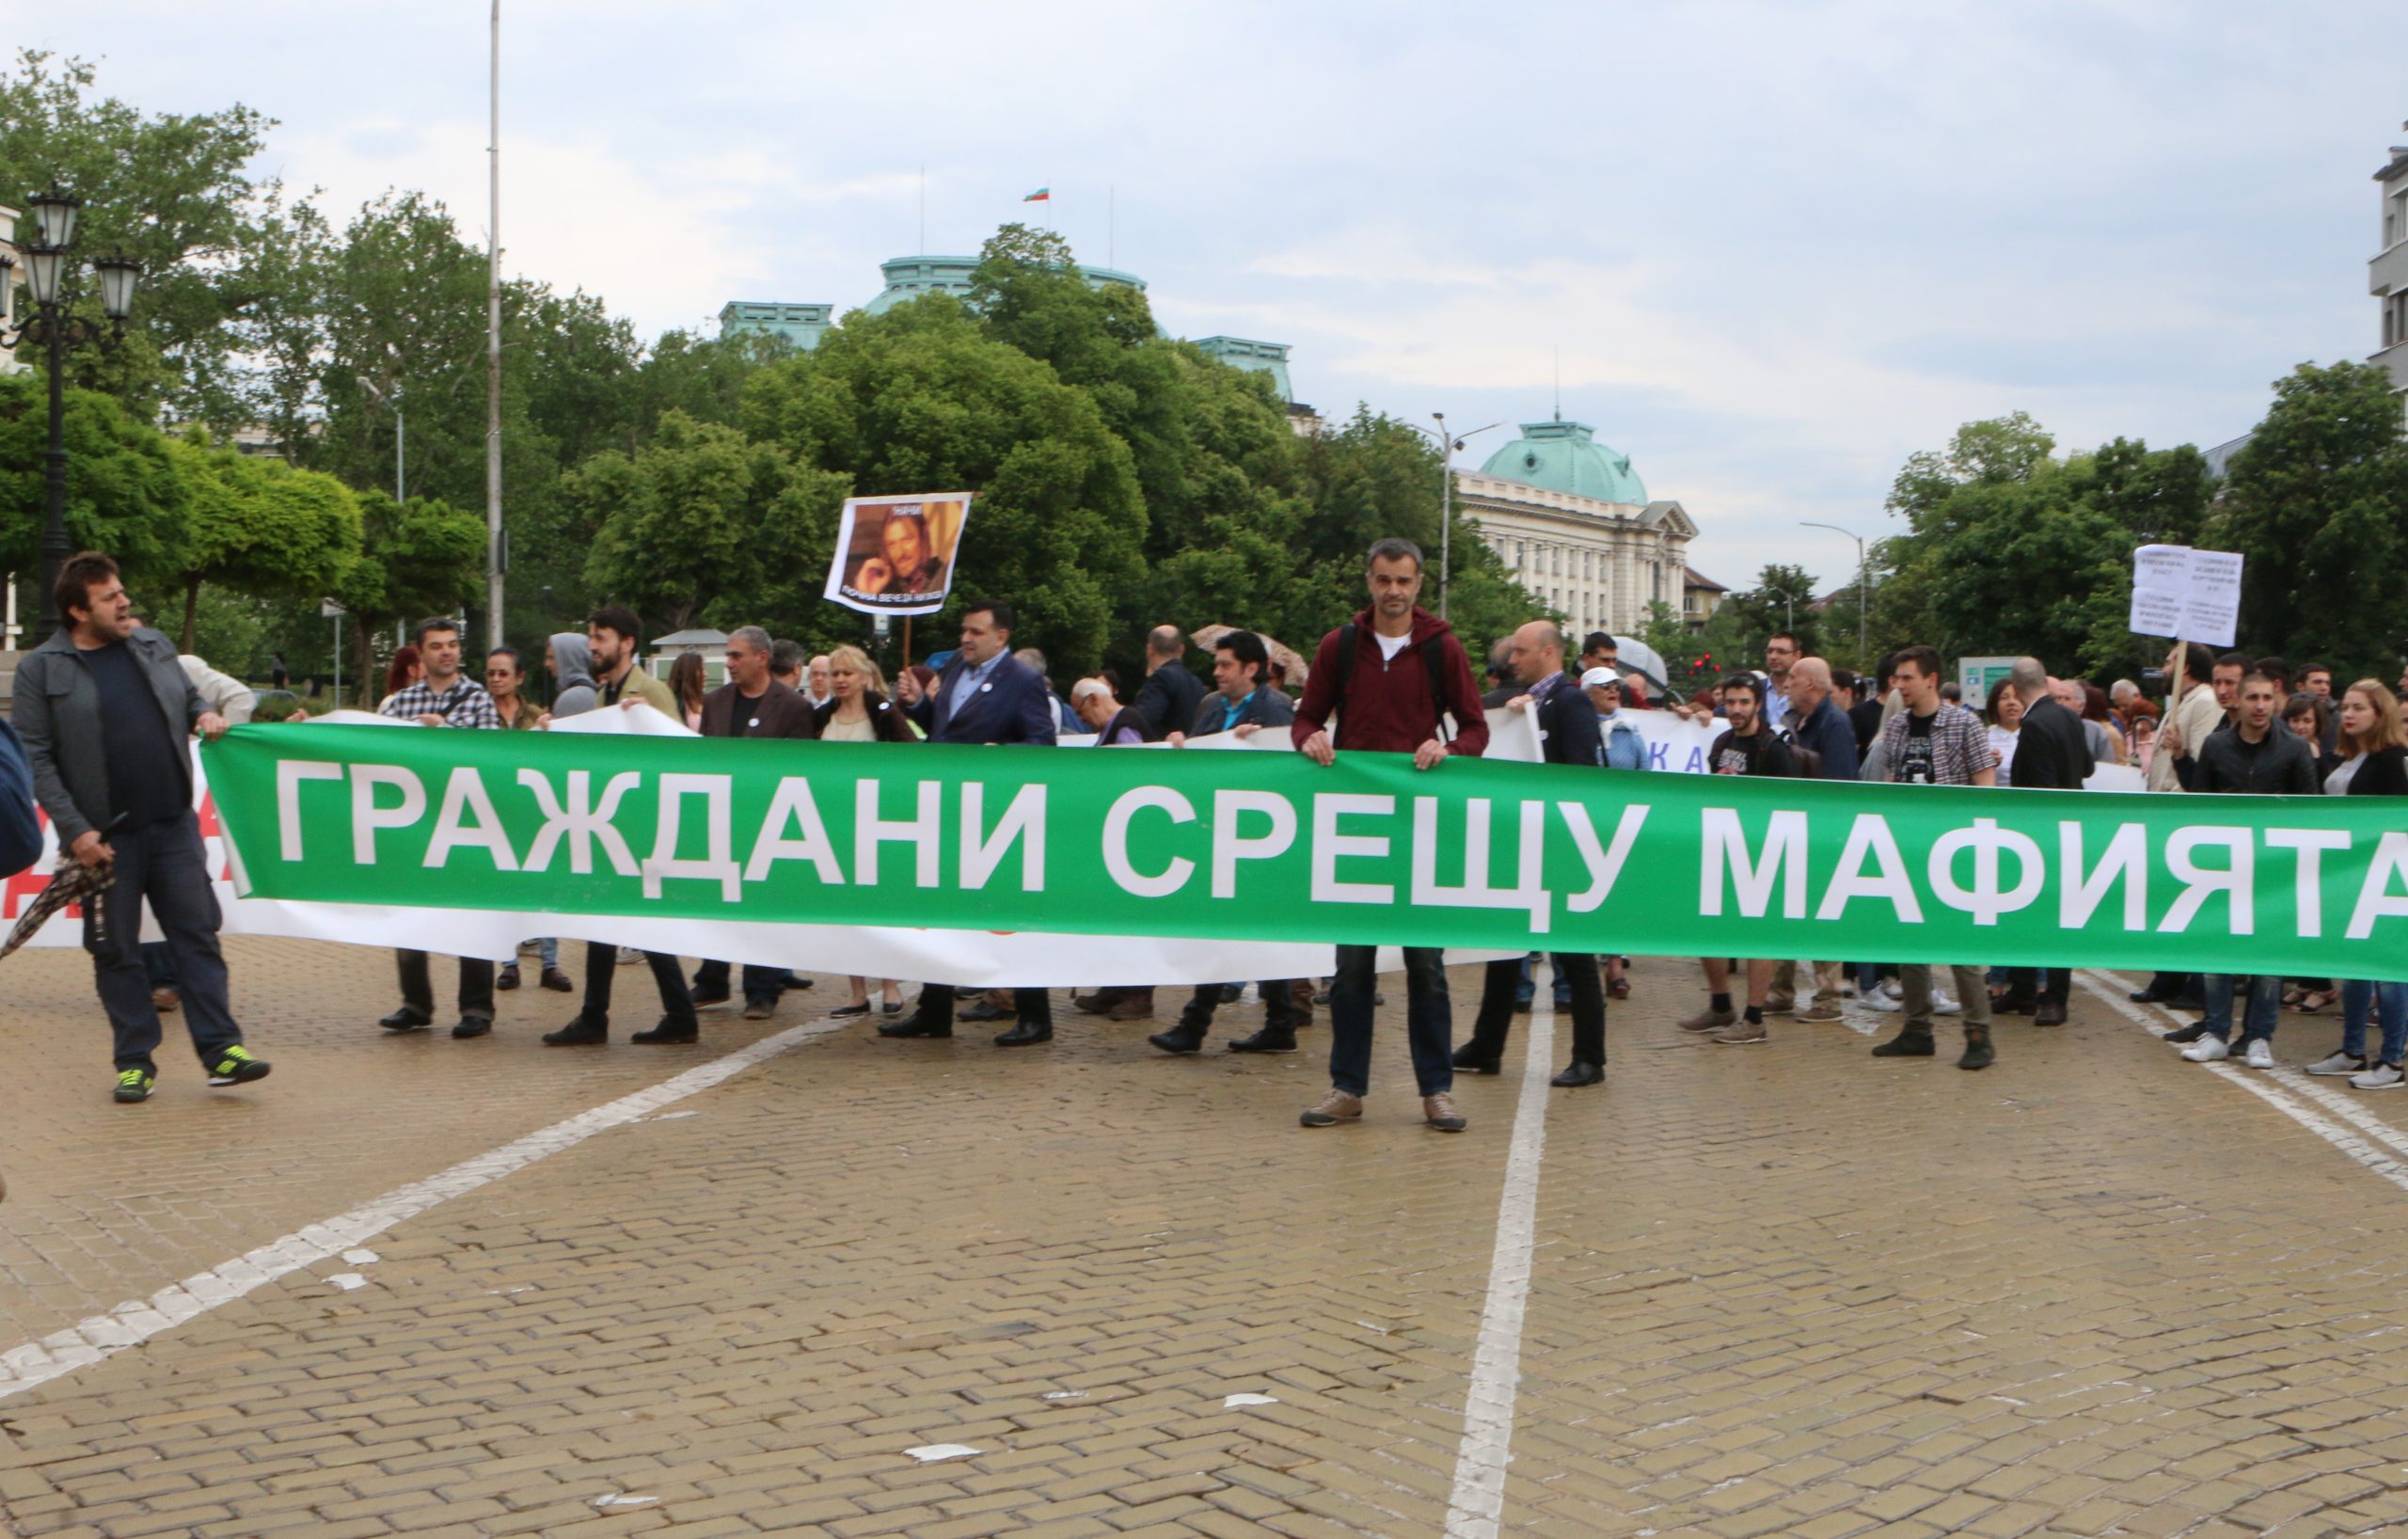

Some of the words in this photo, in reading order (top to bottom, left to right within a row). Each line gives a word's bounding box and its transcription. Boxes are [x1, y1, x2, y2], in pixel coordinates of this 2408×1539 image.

[276, 759, 1047, 902] ГРАЖДАНИ
[1101, 785, 1651, 933] СРЕЩУ
[1700, 806, 2408, 939] МАФИЯТА
